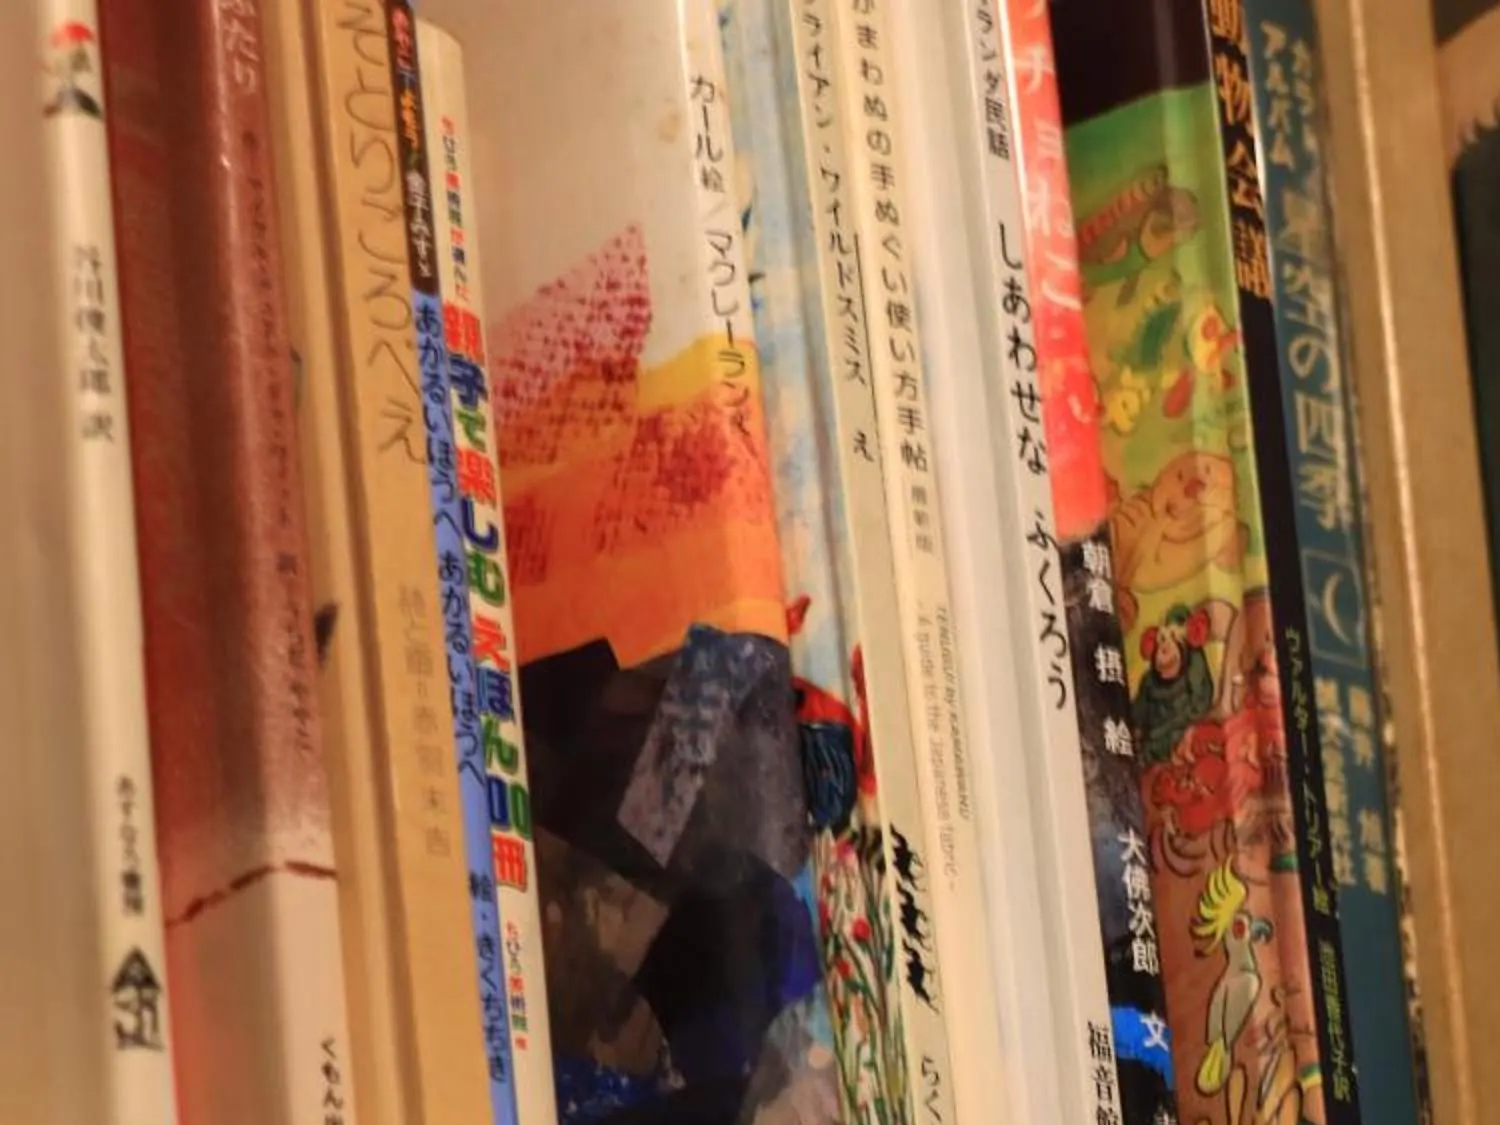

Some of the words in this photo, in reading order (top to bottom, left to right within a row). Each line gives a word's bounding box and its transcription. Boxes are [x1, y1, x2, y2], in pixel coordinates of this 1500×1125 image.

[976, 0, 1010, 161] ランダ民話
[802, 0, 867, 386] ライアン・ワイルドスミス
[852, 431, 873, 463] え
[414, 304, 462, 537] あかるいほうへ
[998, 223, 1047, 475] しあわせな
[1026, 511, 1067, 709] ふくろう
[437, 550, 485, 784] あかるいほうへ
[1118, 826, 1158, 976] 大佛次郎
[1140, 1013, 1170, 1052] 文
